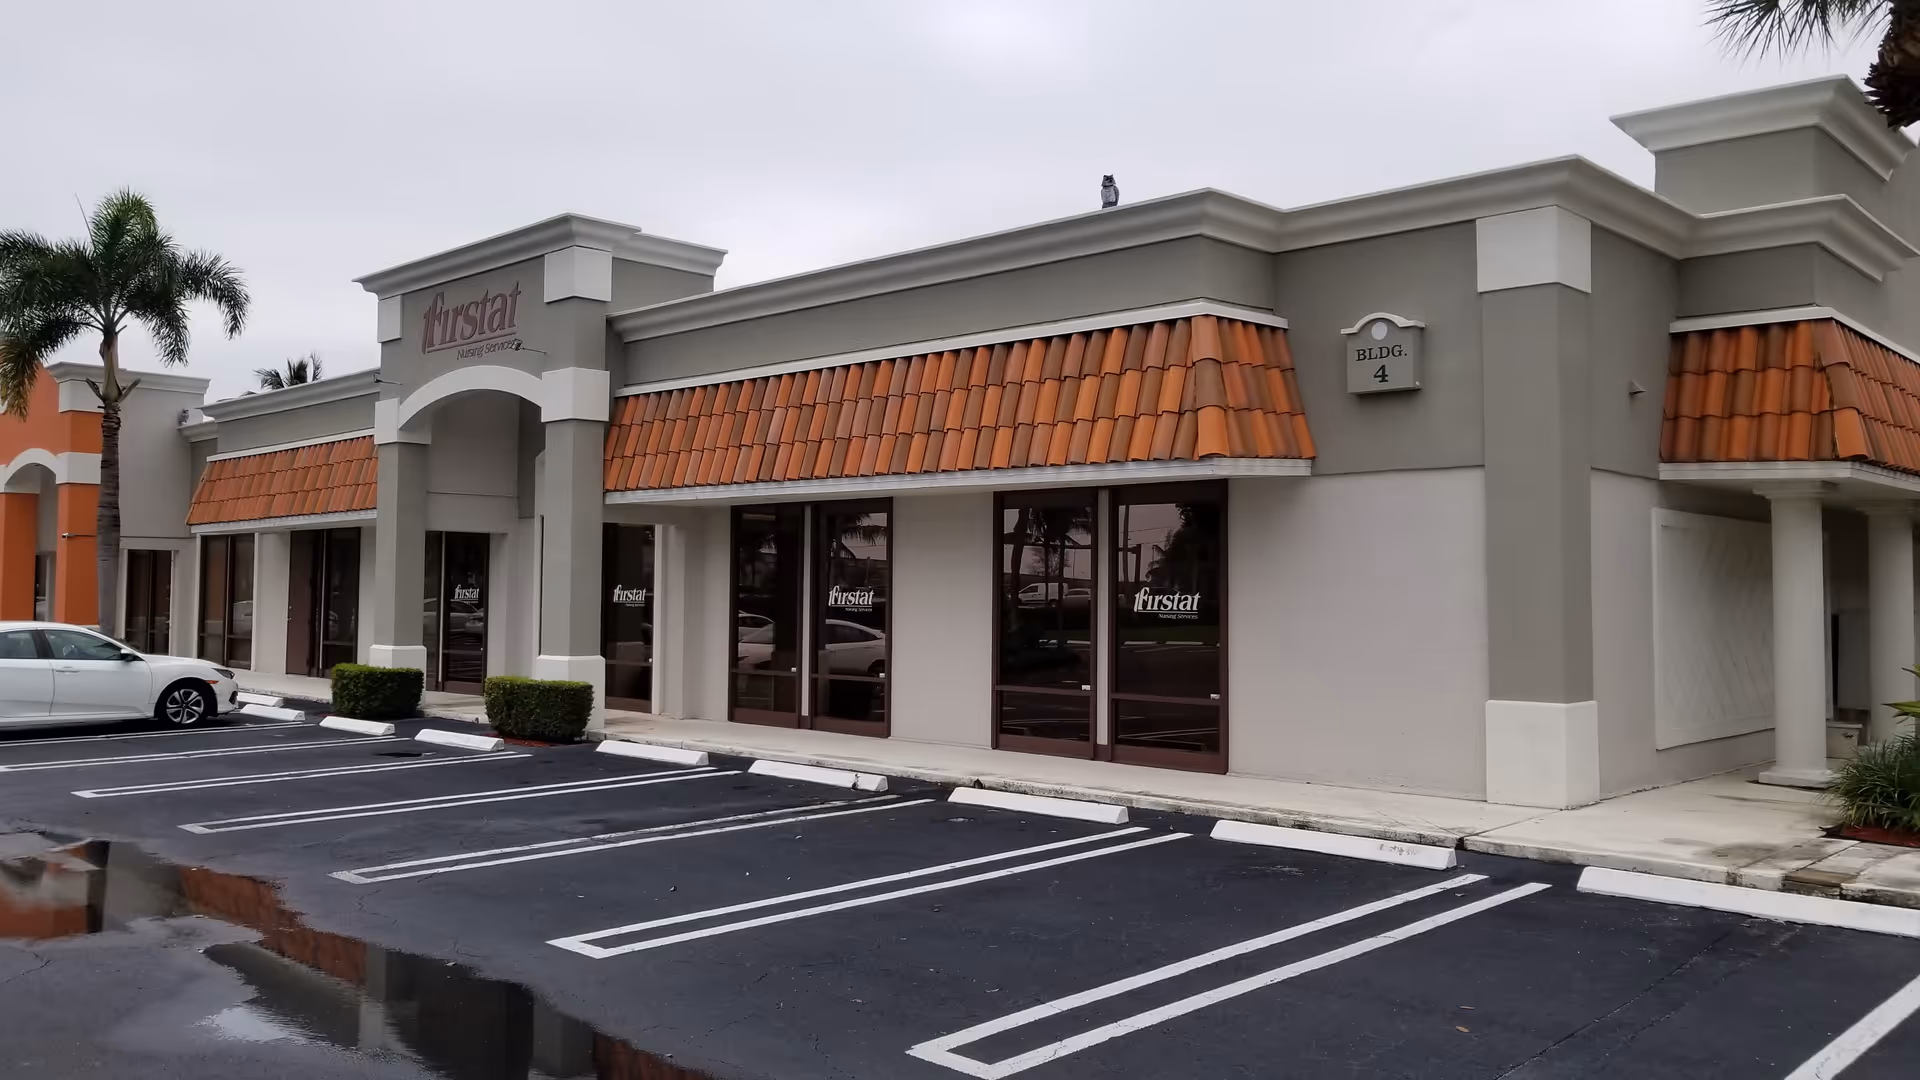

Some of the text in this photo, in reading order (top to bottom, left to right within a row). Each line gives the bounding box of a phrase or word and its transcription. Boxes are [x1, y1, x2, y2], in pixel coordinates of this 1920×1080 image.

[457, 344, 484, 360] Nursing
[1355, 344, 1407, 361] BLDG.
[1373, 364, 1389, 383] 4
